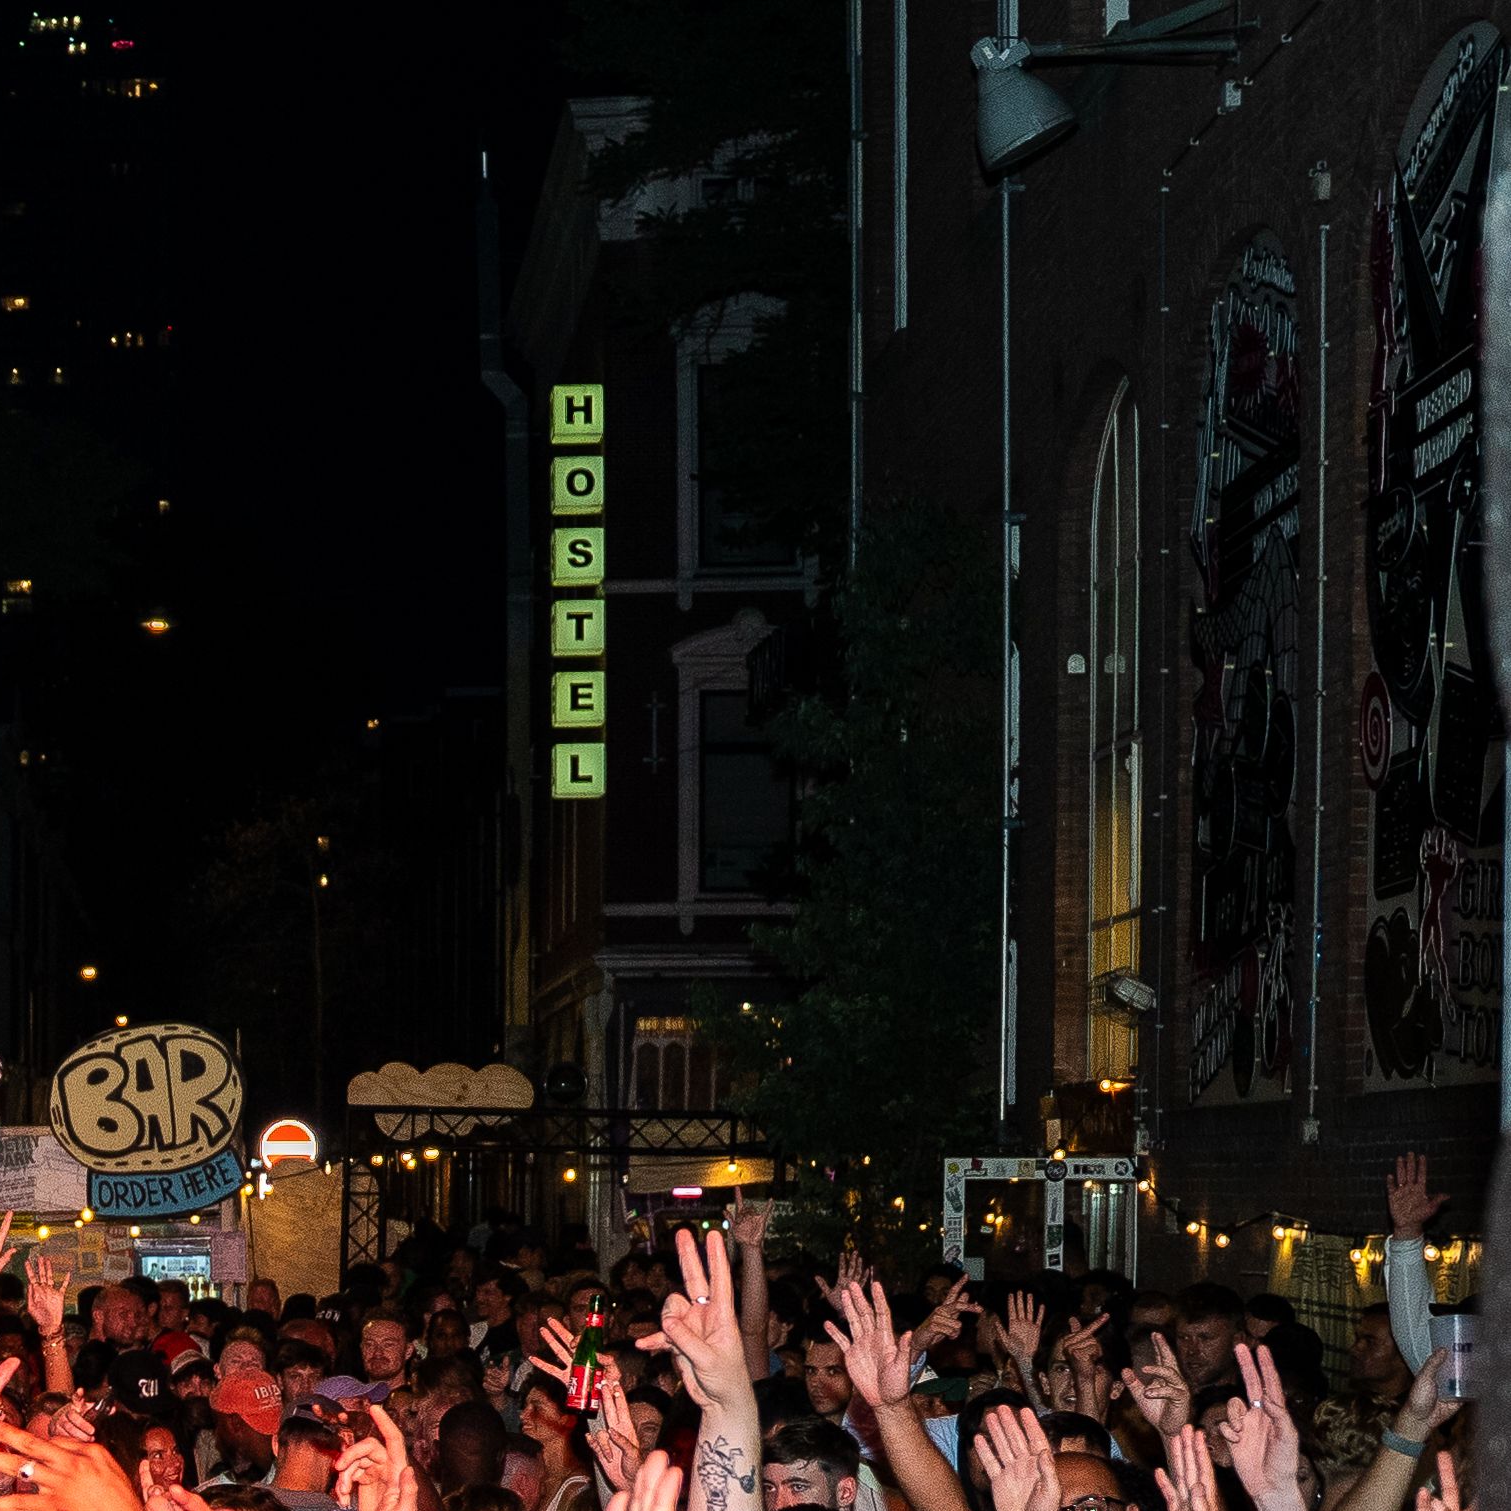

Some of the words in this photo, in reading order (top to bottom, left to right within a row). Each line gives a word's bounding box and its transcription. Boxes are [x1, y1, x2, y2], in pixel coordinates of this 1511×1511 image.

[564, 396, 595, 783] HOSTEL
[57, 1034, 233, 1158] BAR
[97, 1177, 174, 1209] ORDER
[181, 1162, 234, 1198] HERE
